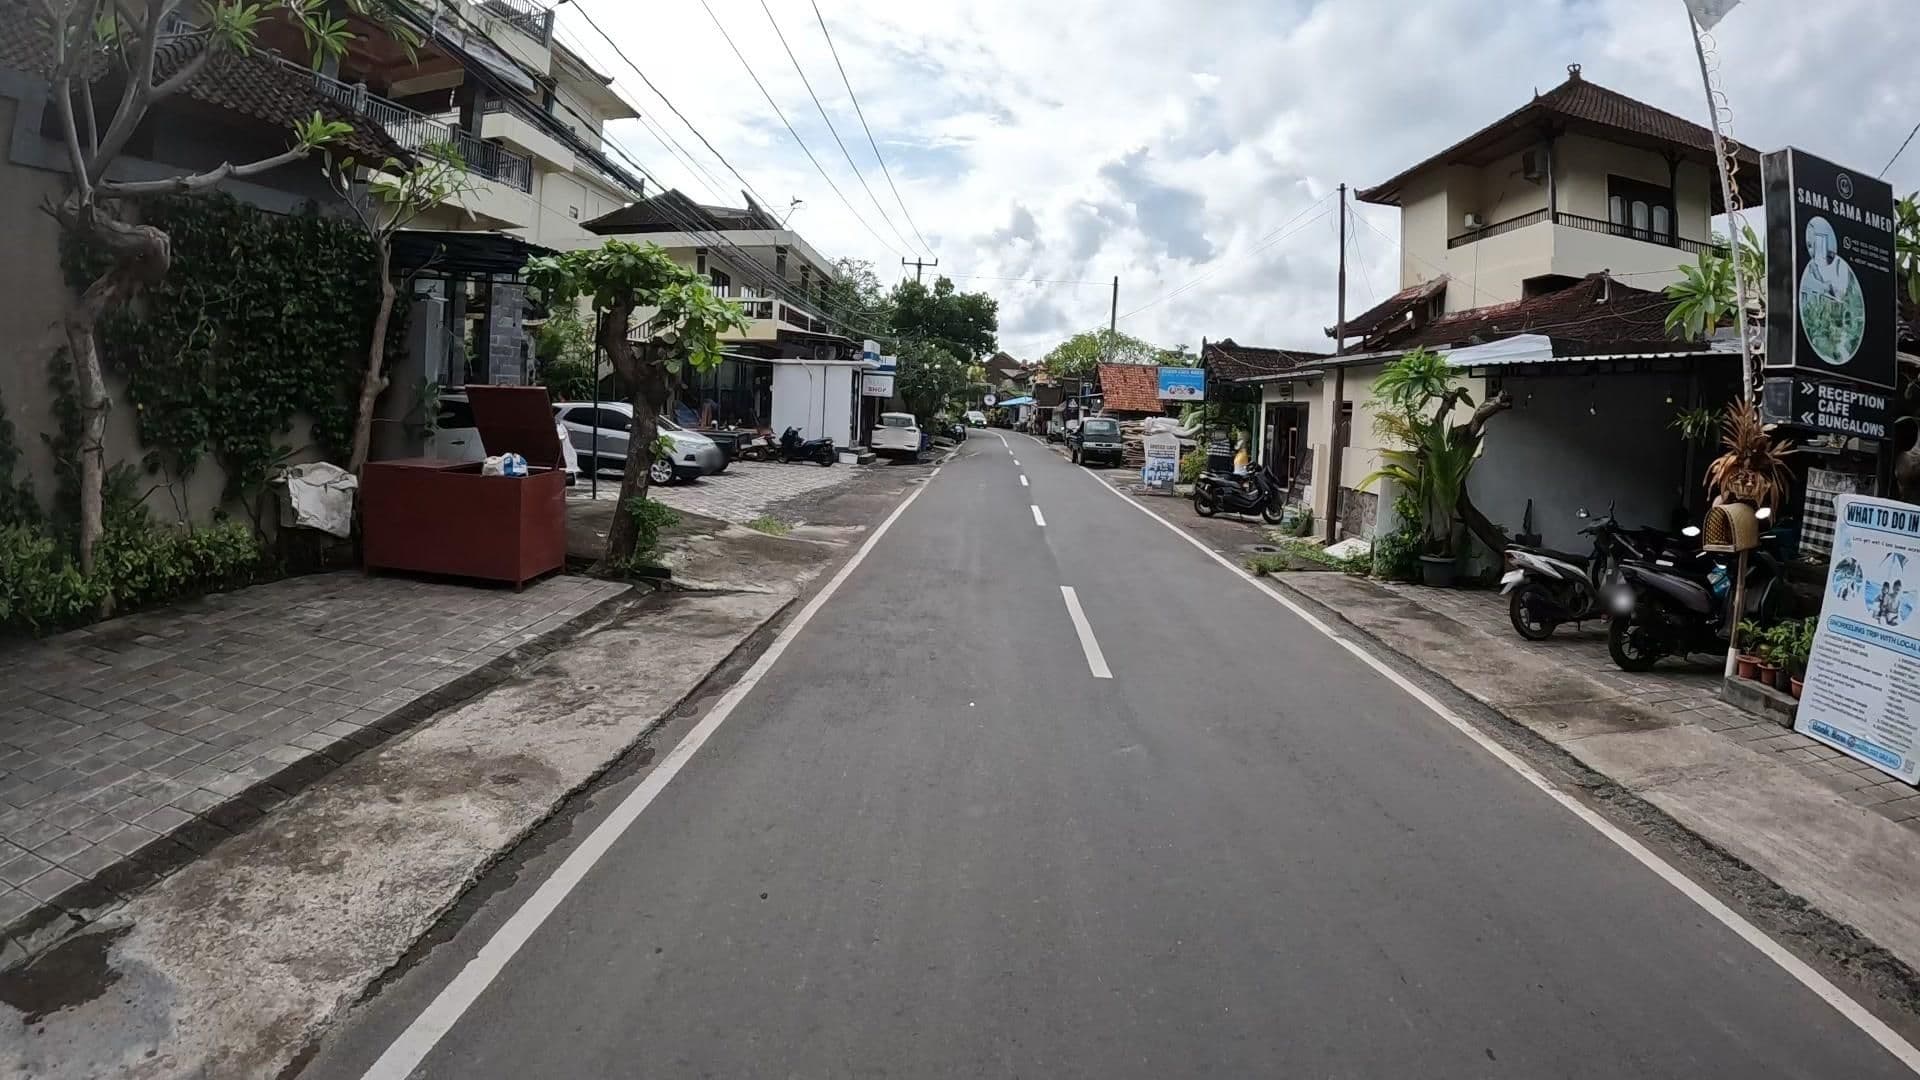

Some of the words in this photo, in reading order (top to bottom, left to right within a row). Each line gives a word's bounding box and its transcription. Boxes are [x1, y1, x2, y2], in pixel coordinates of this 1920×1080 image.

[1798, 187, 1829, 211] SAMA
[1832, 199, 1861, 222] SAMA
[1818, 385, 1885, 410] RECEPTION
[1818, 399, 1850, 417] CAFE
[1817, 413, 1885, 437] BUNGALOWS
[1847, 504, 1874, 525] WHAT
[1876, 508, 1889, 528] TO
[1891, 511, 1906, 531] DO
[1908, 513, 1920, 533] IN
[1829, 618, 1865, 634] SNORKELING
[1866, 629, 1880, 640] TRIP
[1880, 633, 1897, 646] WITH
[1897, 638, 1917, 652] LOCAL
